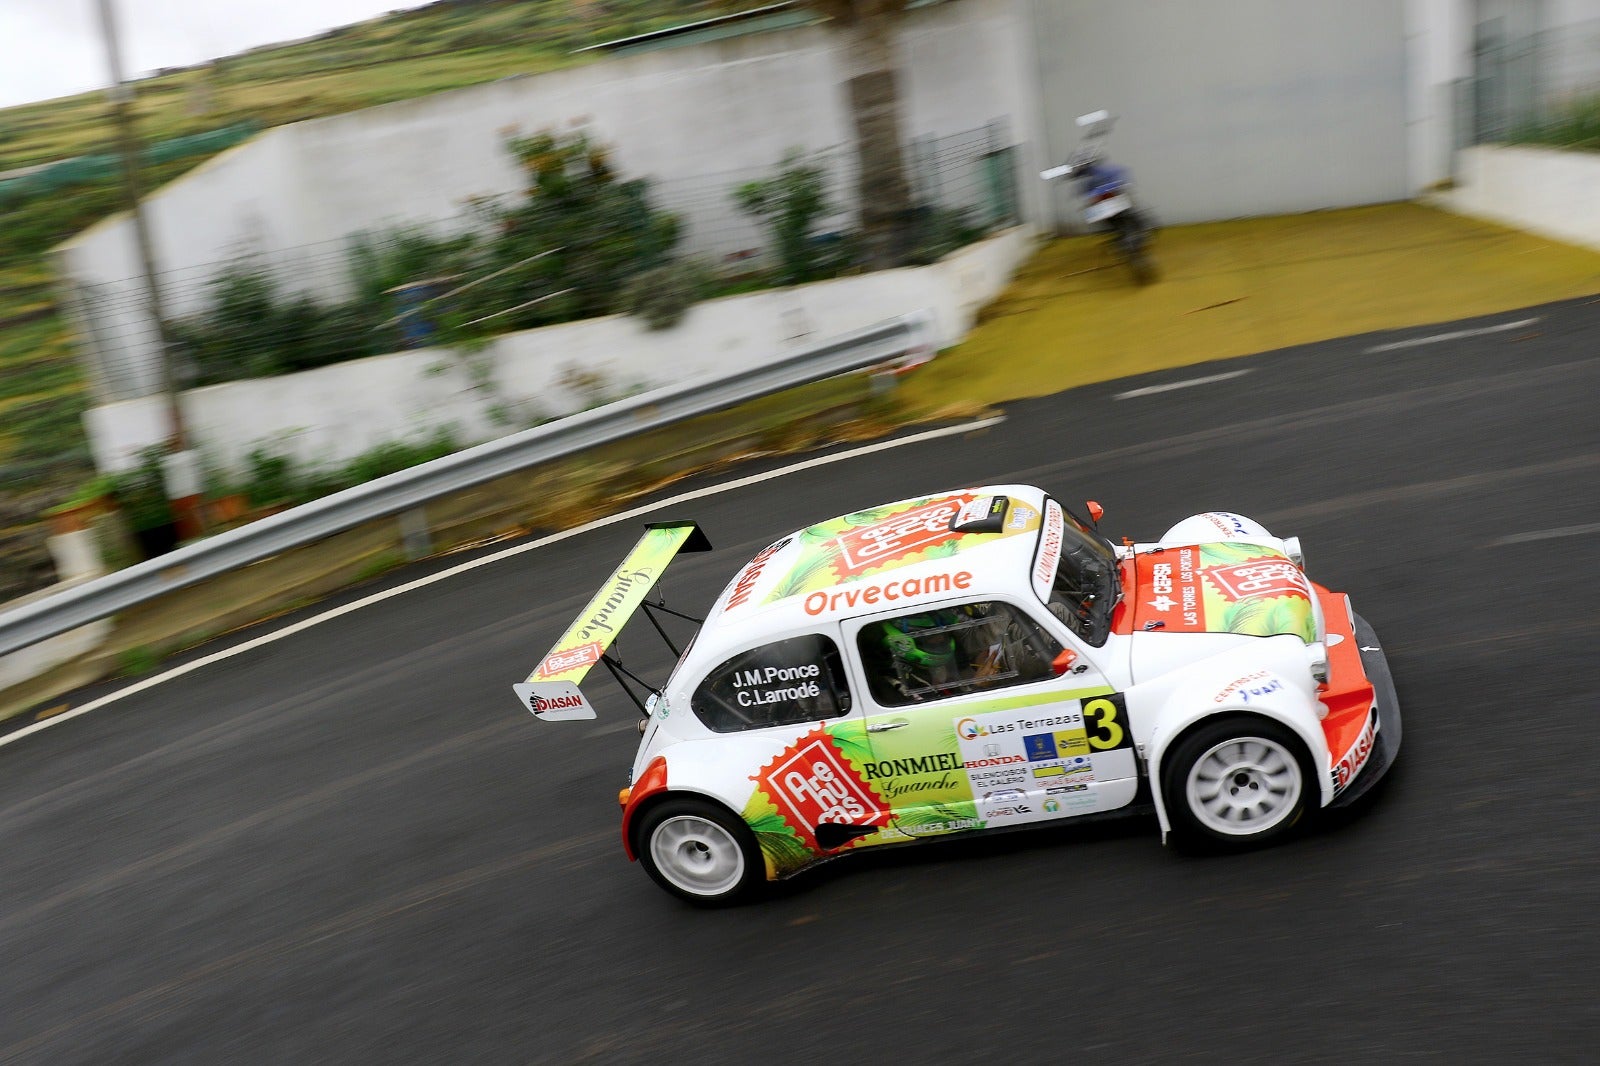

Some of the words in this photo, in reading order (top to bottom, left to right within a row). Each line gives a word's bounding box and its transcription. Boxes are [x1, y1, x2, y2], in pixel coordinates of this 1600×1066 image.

[1180, 548, 1193, 572] PORTALES
[1153, 563, 1173, 594] CEPSA
[1180, 571, 1194, 583] LOS
[804, 571, 973, 616] Orvecame
[1182, 586, 1197, 611] TORRES
[1183, 611, 1198, 626] LAS
[732, 664, 820, 688] J.M.Ponce
[536, 695, 582, 711] DIASAN
[737, 681, 820, 707] C.Larrodé
[989, 721, 1015, 735] Las
[1016, 713, 1081, 730] Terrazas
[1083, 699, 1123, 750] 3
[863, 752, 965, 780] RONMIEL
[965, 755, 1026, 768] HONDA
[881, 771, 959, 799] Guanche
[970, 767, 1027, 781] SILENCIOSOS
[990, 776, 1025, 787] CALERO
